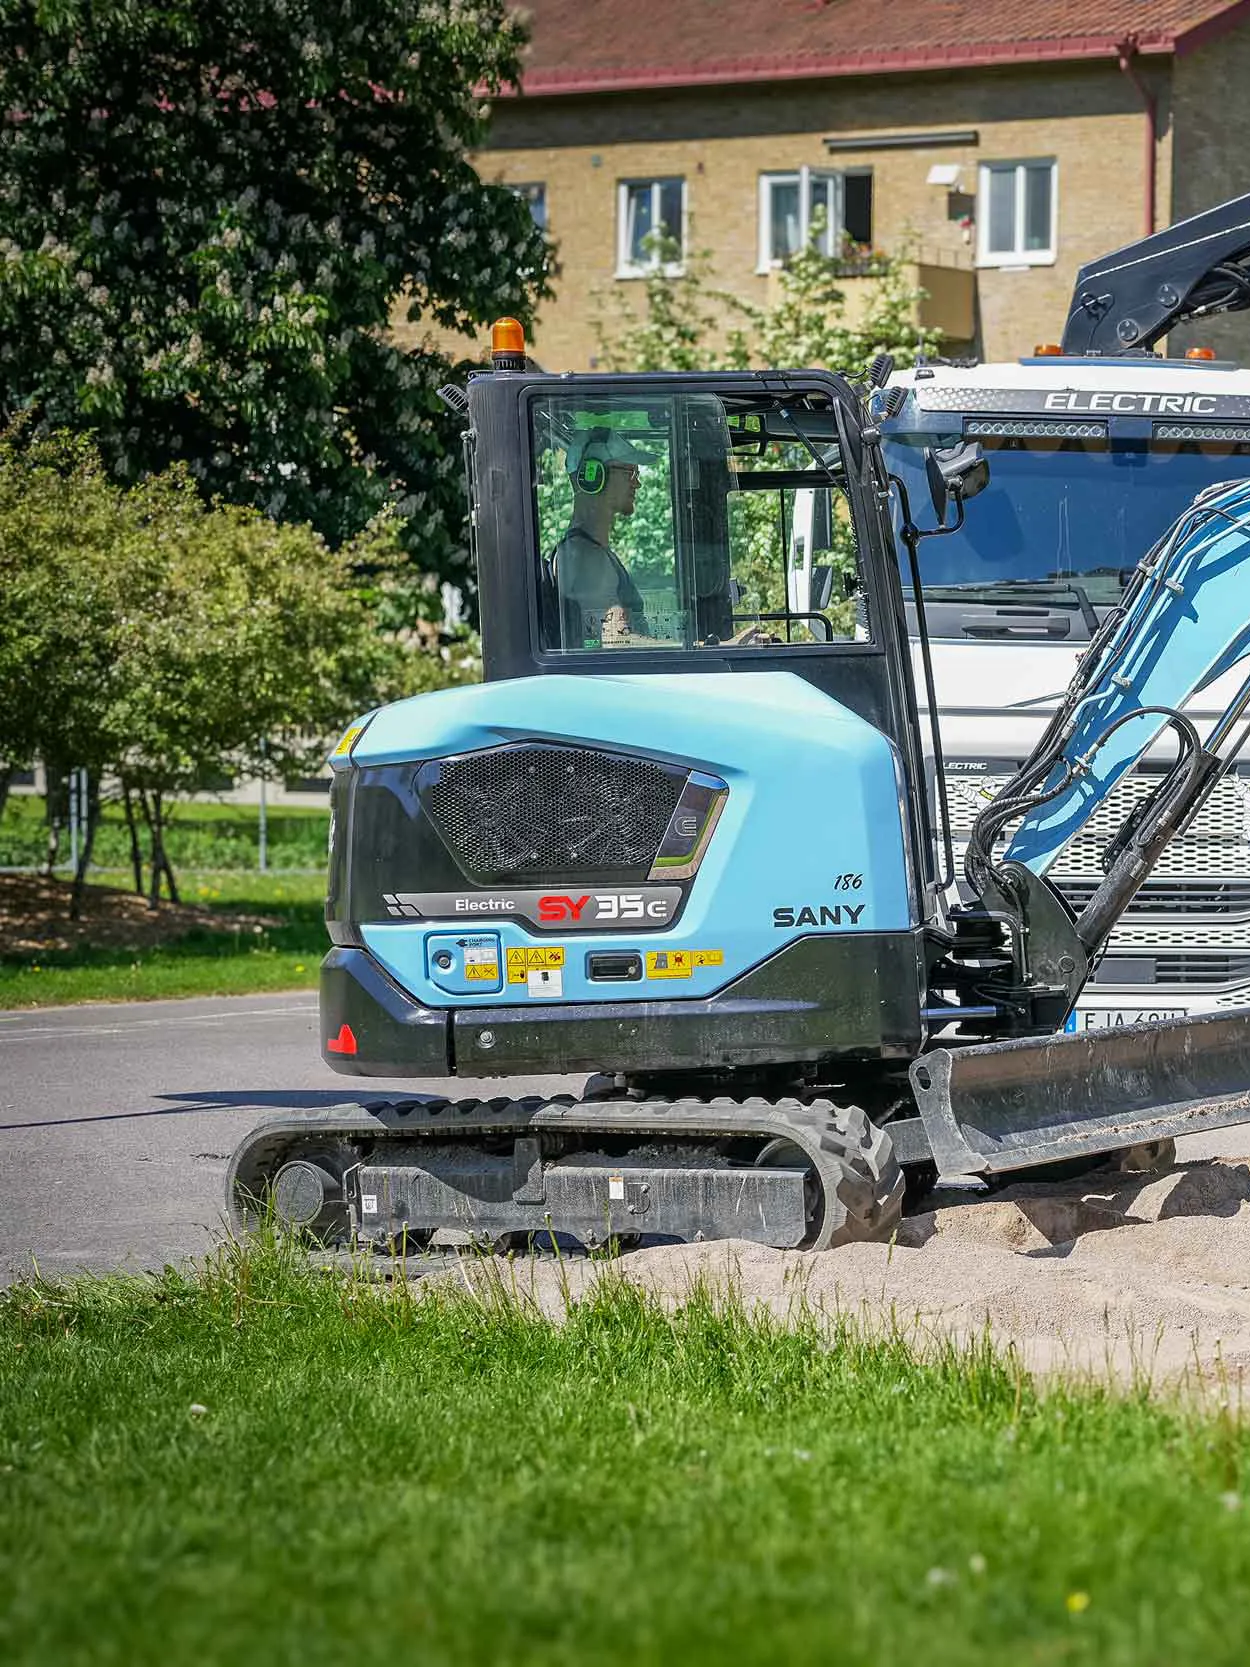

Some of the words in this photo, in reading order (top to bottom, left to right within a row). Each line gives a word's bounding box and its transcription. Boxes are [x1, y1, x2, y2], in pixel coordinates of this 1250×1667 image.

[1044, 392, 1217, 414] ELECTRIC
[943, 762, 988, 770] LECTRIC
[833, 873, 864, 890] 186
[455, 899, 515, 912] Electric
[773, 904, 865, 927] SANY
